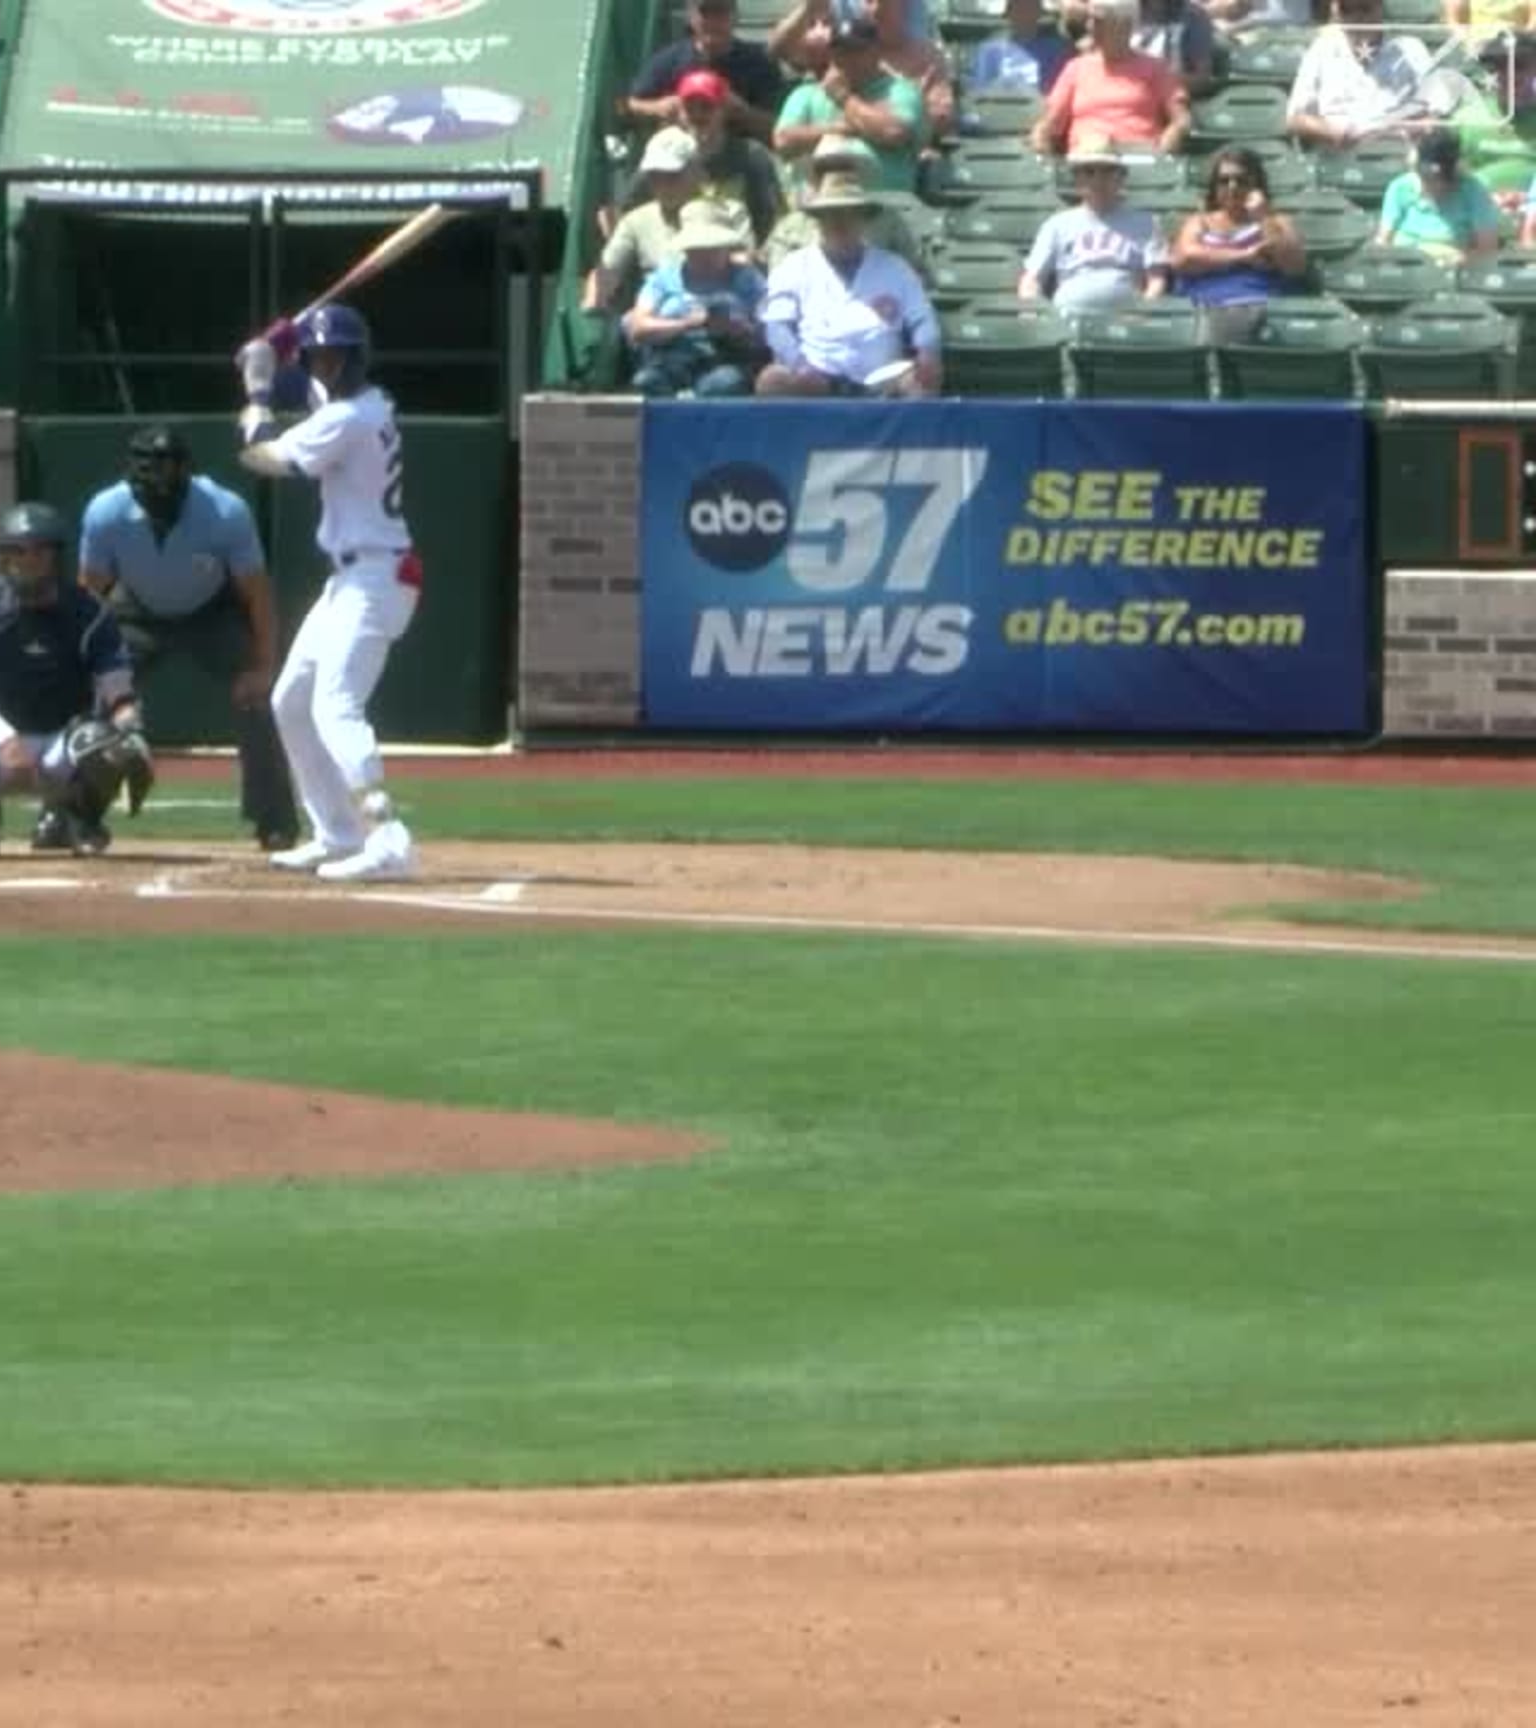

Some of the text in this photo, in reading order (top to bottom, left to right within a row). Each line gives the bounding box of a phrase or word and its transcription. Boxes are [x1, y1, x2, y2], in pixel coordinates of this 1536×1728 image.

[690, 448, 989, 591] abc 57
[1026, 471, 1266, 520] SEE THE
[1005, 527, 1324, 567] DIFFERENCE
[690, 604, 975, 677] NEWS
[1004, 598, 1305, 645] abc57.com
